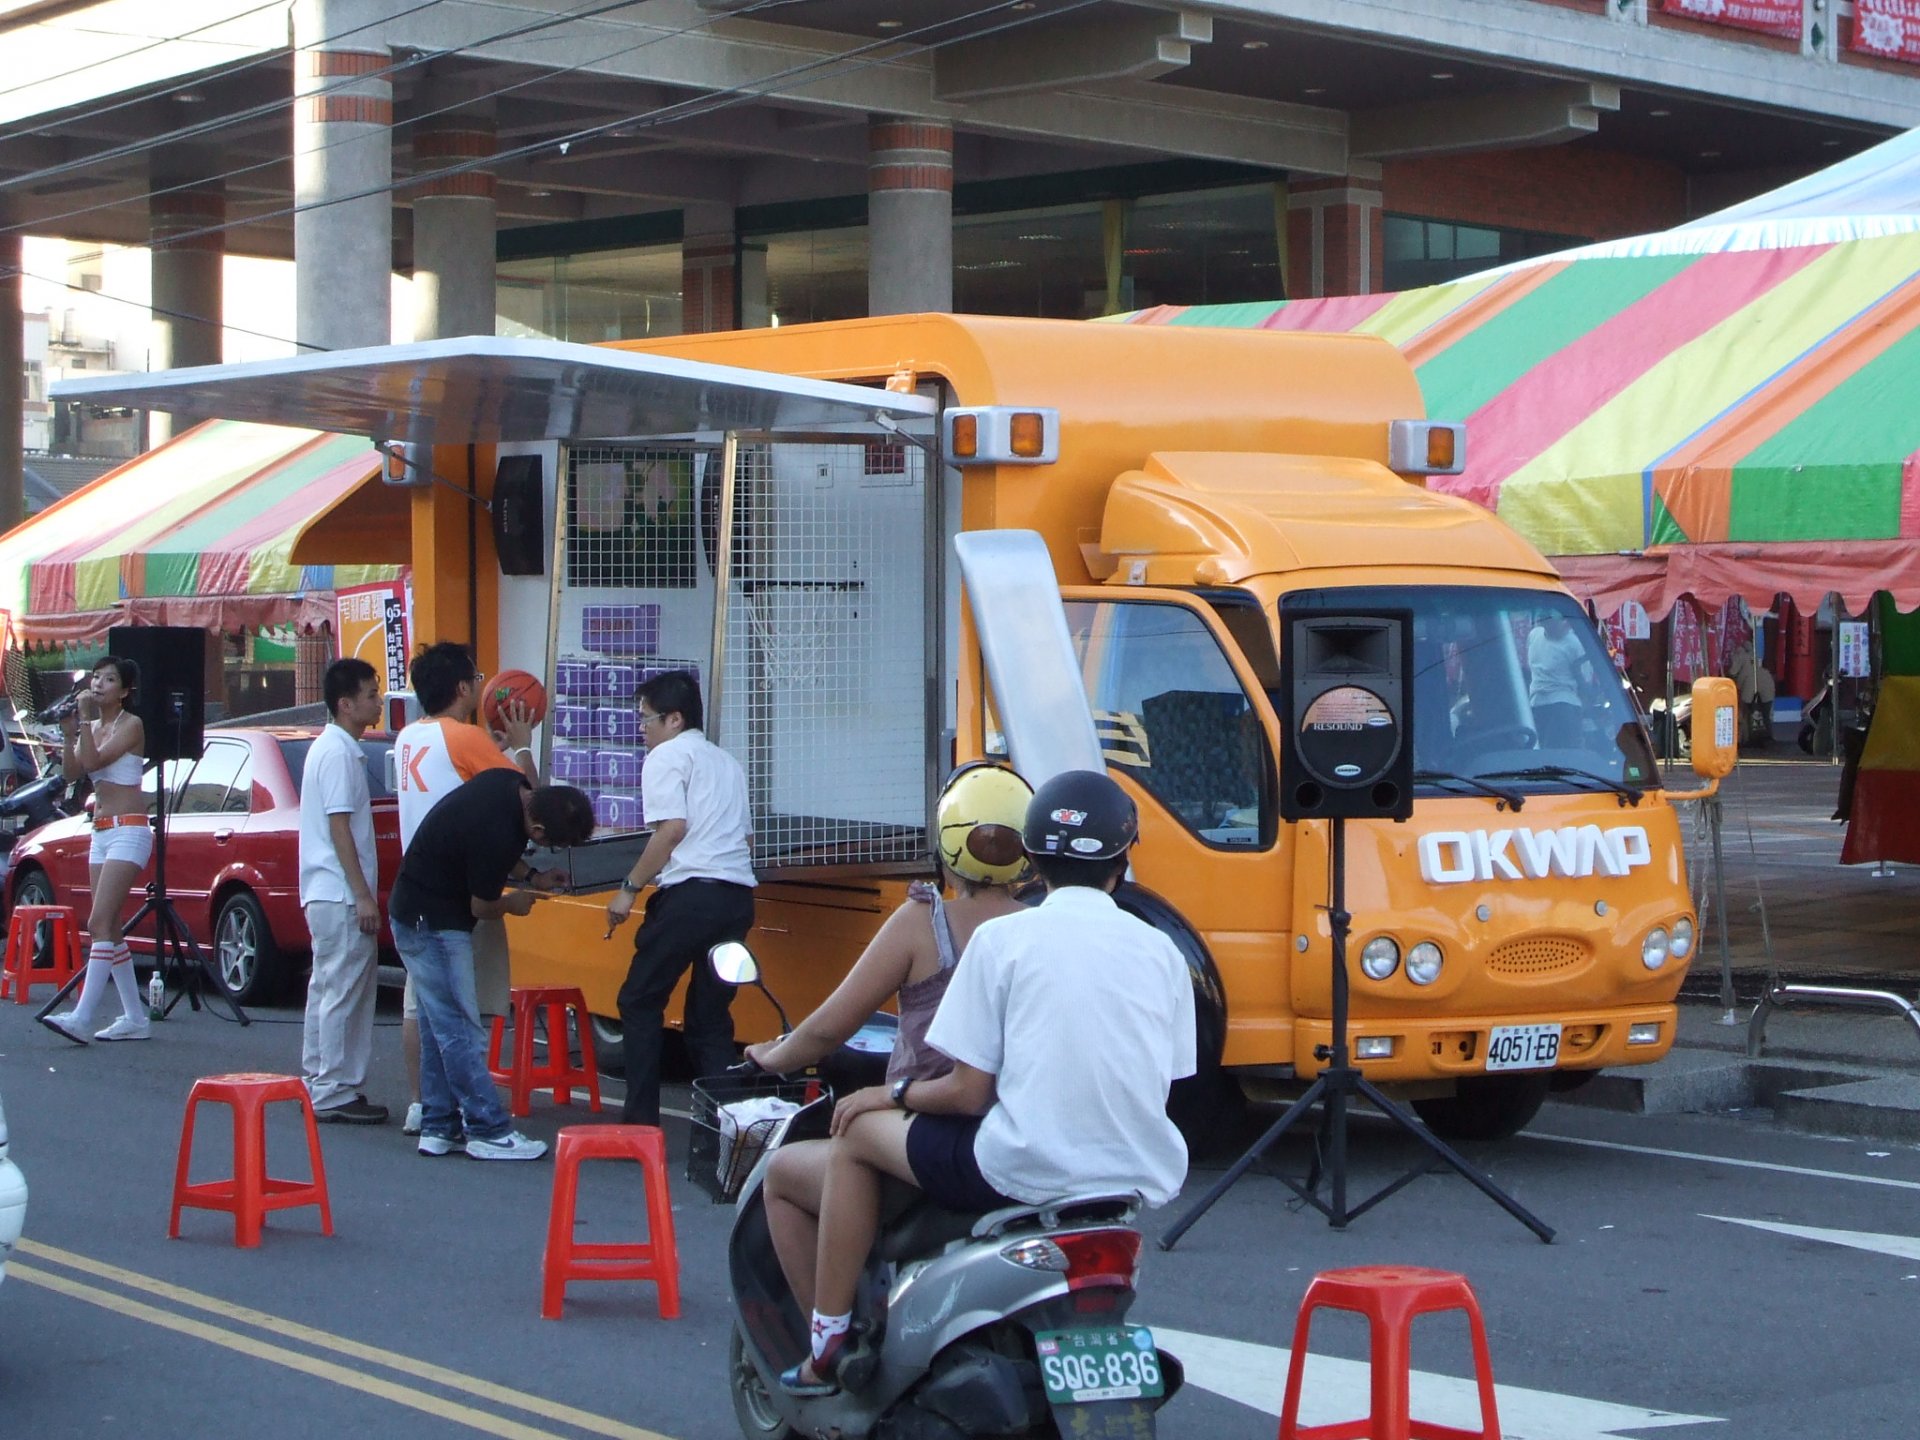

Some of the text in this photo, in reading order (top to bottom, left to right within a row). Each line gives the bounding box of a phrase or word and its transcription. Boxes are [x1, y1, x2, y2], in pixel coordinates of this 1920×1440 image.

[386, 604, 401, 623] 95
[564, 669, 571, 689] 1
[607, 671, 617, 691] 2
[562, 712, 572, 732] 4
[607, 714, 617, 734] 5
[563, 756, 572, 776] 7
[608, 758, 618, 779] 8
[1418, 824, 1651, 883] OKWAP
